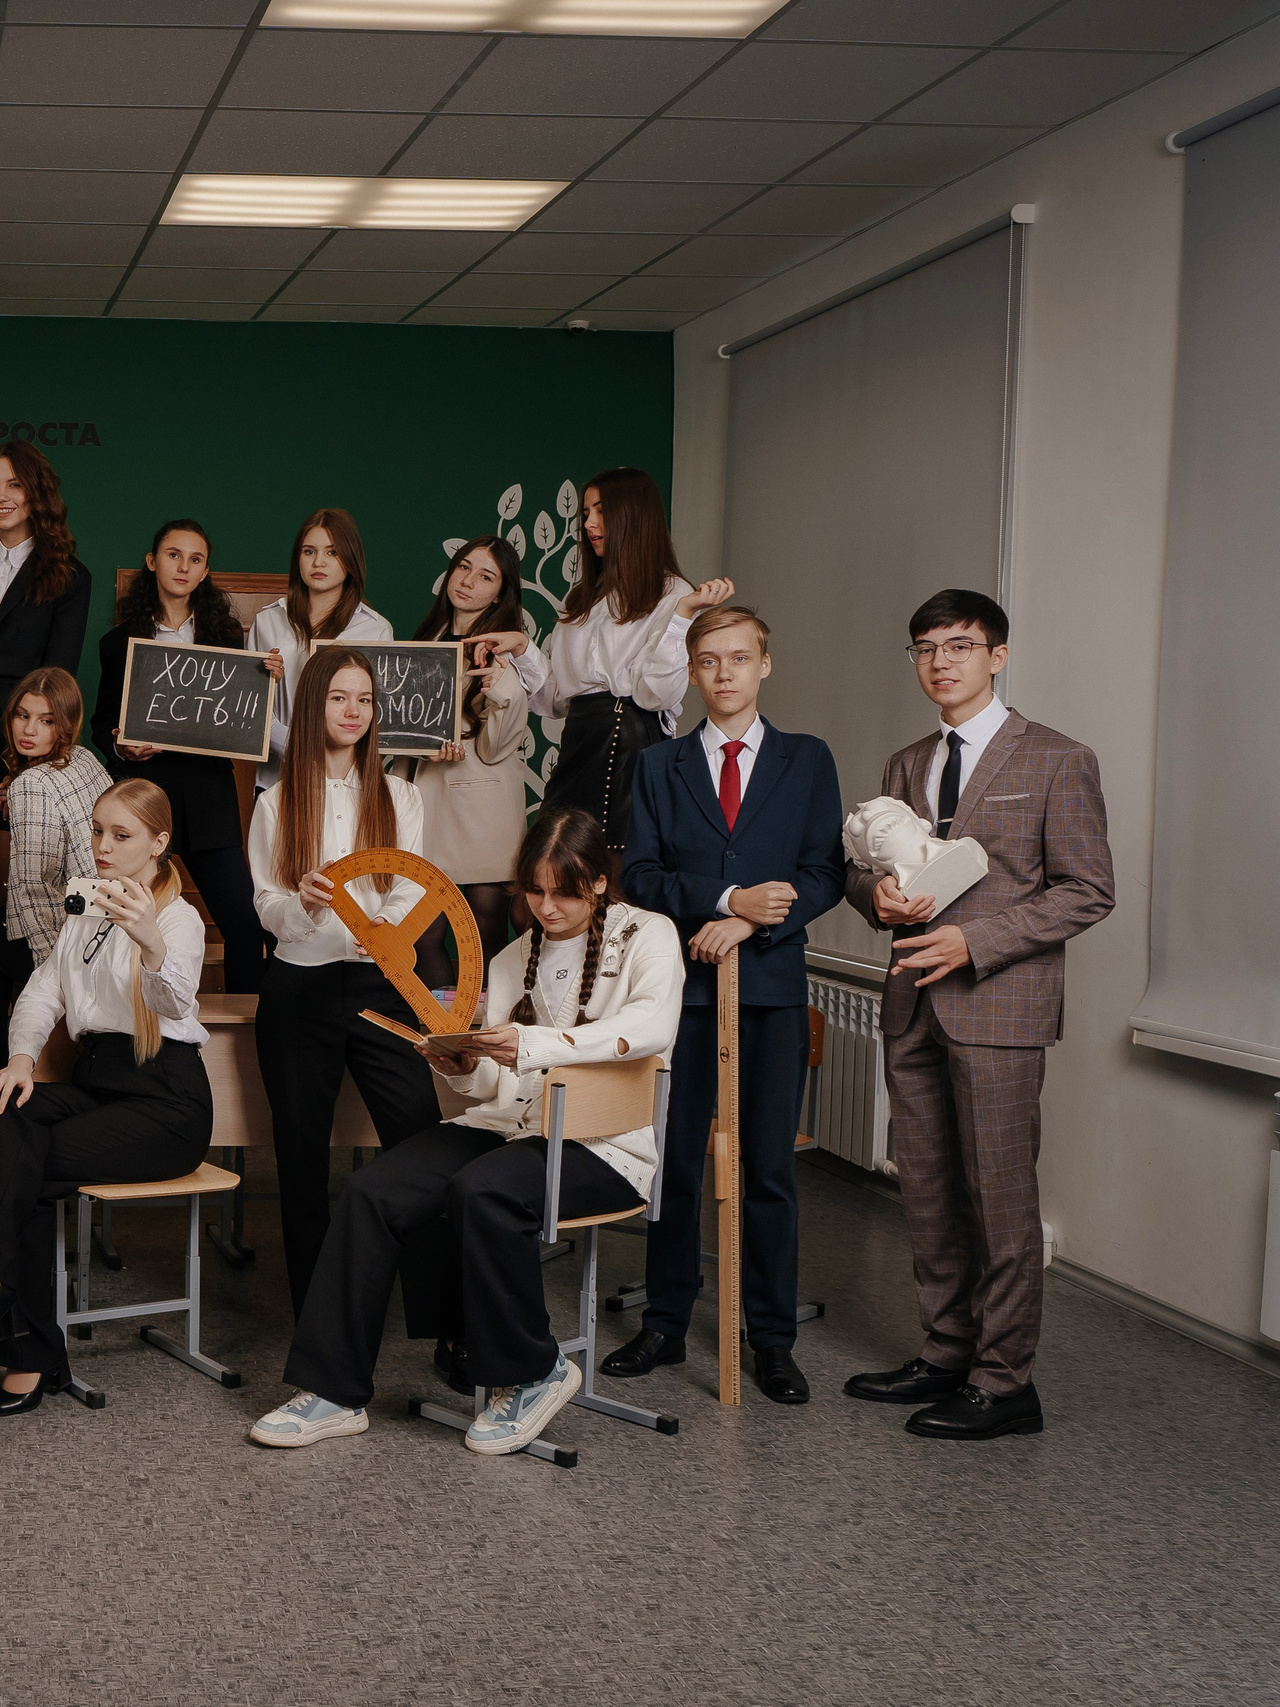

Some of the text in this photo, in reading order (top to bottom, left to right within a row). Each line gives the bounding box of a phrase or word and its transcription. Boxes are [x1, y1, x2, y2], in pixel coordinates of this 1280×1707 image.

[152, 652, 238, 692] ХОЧУ
[377, 654, 413, 695] ЧУ
[145, 690, 260, 731] ЕСТЬ!!!
[376, 676, 455, 736] МОЙ!
[438, 886, 448, 896] 90
